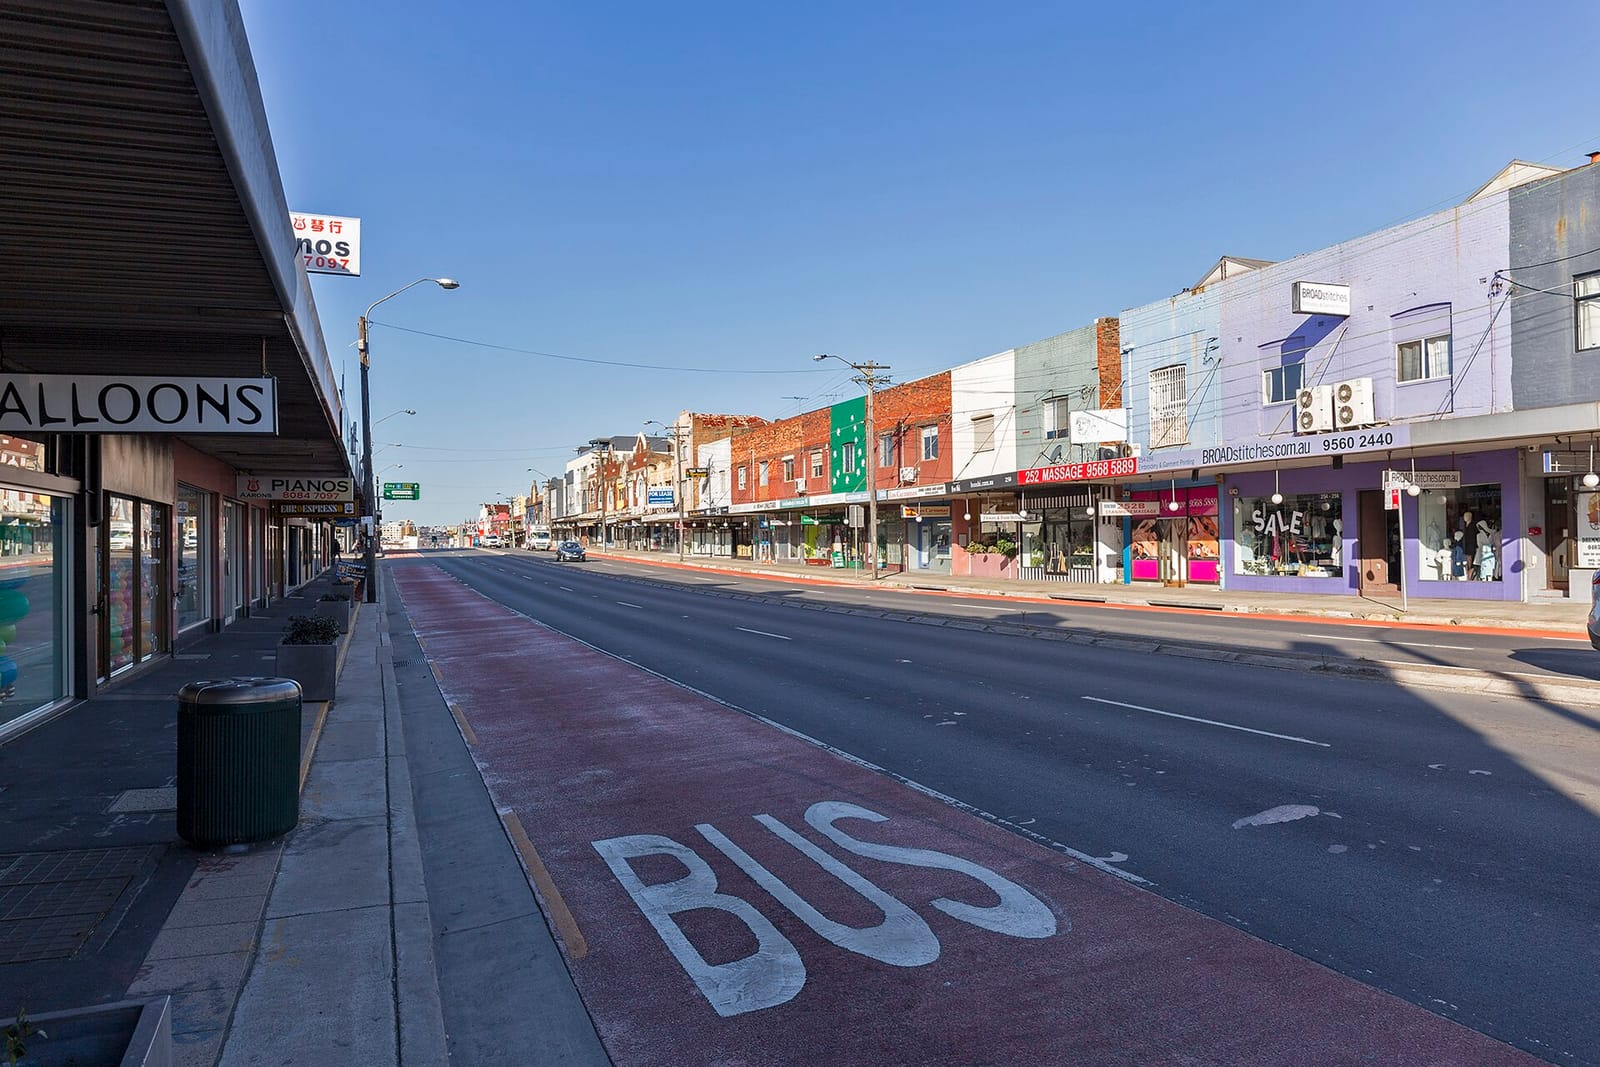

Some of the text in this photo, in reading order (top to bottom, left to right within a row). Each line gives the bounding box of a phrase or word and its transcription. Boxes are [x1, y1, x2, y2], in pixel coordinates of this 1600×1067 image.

[1323, 437, 1354, 451] 9560
[1359, 432, 1393, 448] 2440
[1025, 459, 1134, 483] 252 MASSAGE 9568 5889
[271, 479, 349, 493] PIANOS
[315, 492, 340, 500] 7097
[1252, 510, 1303, 537] SALE
[591, 801, 1057, 1017] BUS
